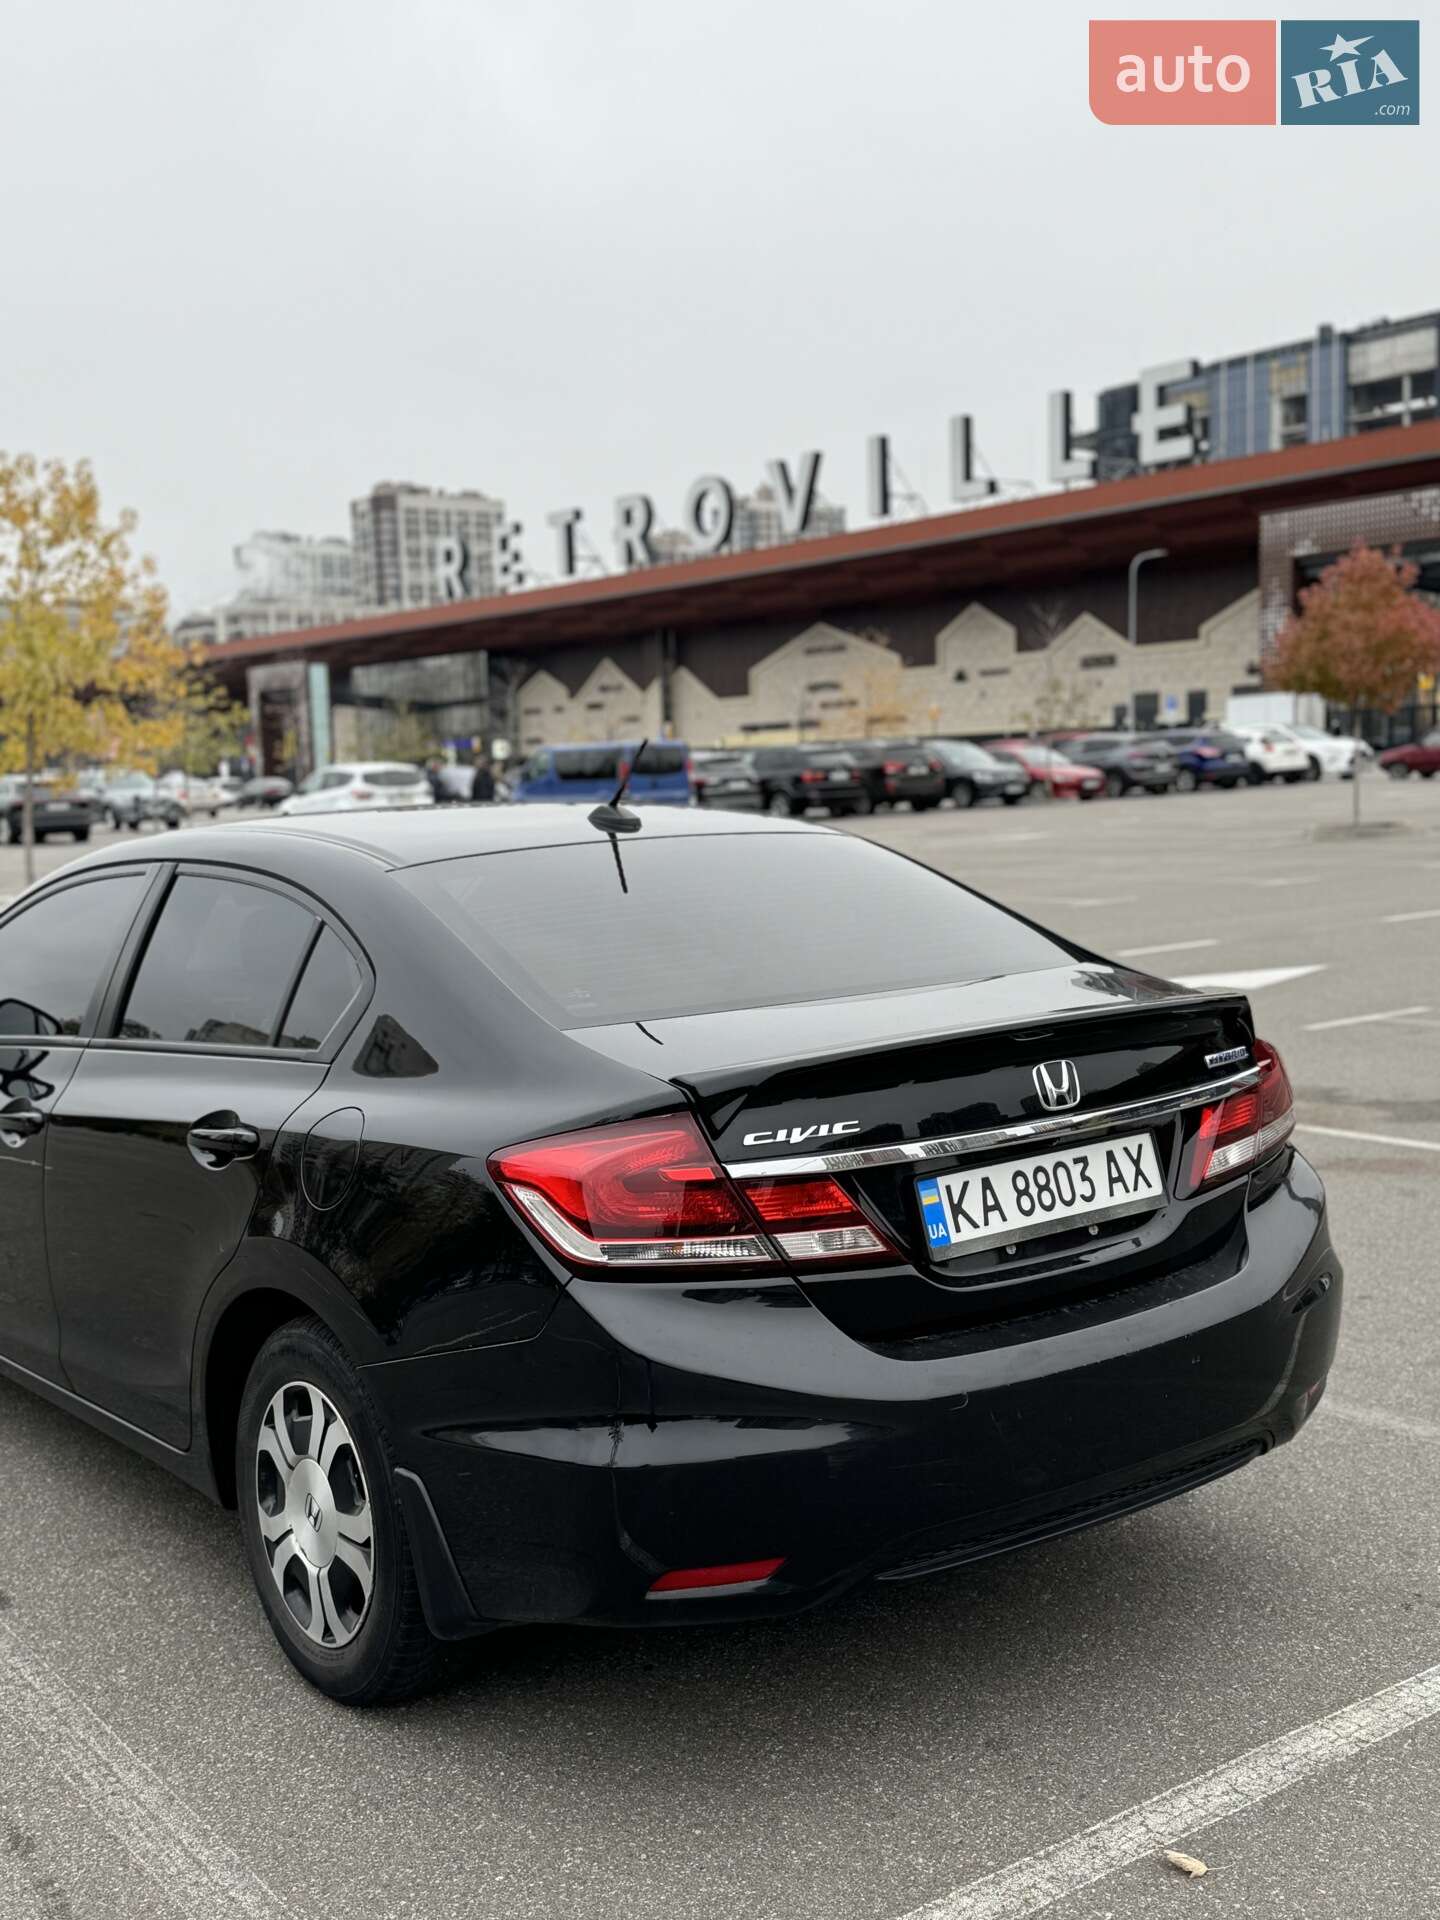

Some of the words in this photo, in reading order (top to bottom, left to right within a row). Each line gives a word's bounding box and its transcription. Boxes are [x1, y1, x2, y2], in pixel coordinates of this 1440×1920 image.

[434, 358, 1201, 599] RETROVILLE
[743, 1119, 861, 1145] CIVIC
[945, 1176, 1008, 1233] KA
[1011, 1155, 1096, 1217] 8803
[1105, 1143, 1153, 1198] AX
[928, 1224, 948, 1240] UA
